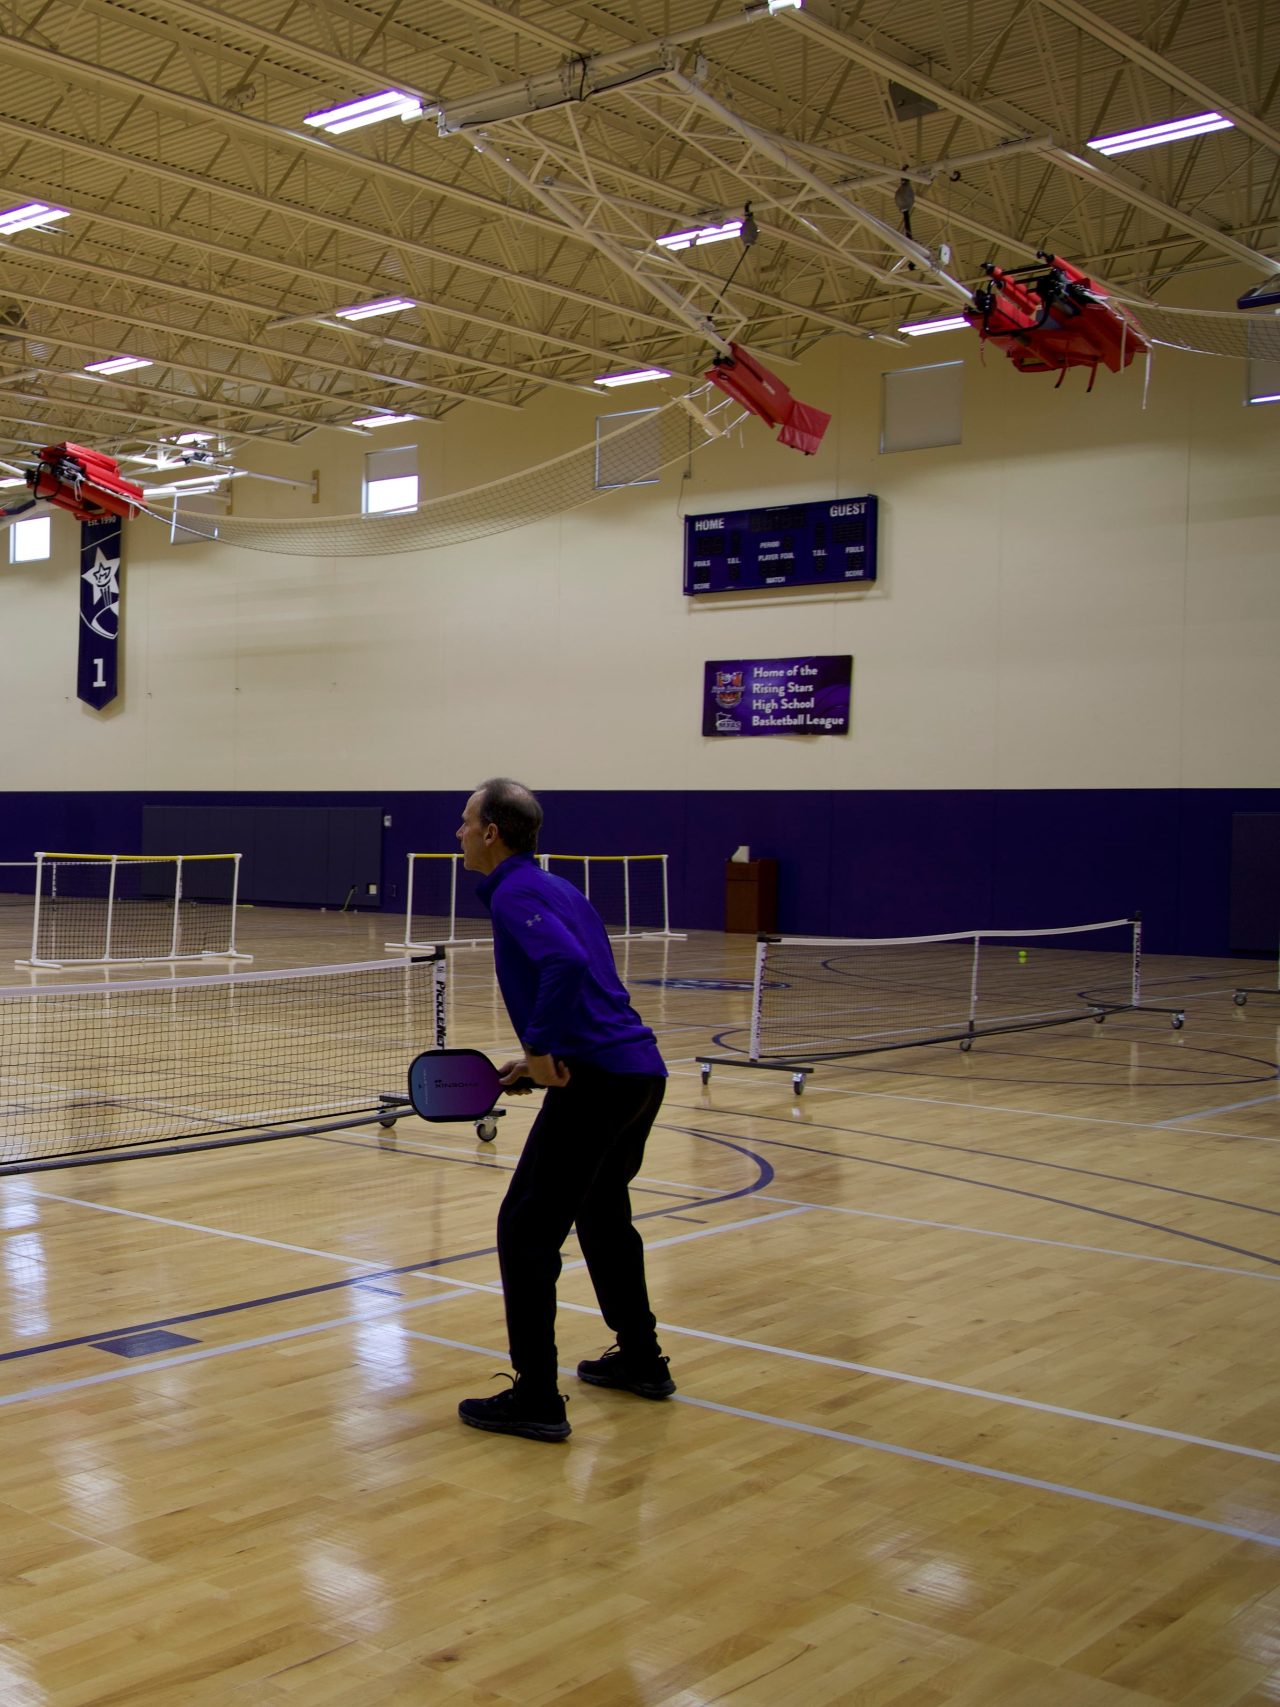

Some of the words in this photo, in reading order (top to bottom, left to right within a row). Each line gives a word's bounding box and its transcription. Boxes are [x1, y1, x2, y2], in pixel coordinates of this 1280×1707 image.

[829, 502, 868, 518] GUEST
[694, 517, 725, 532] HOME
[92, 658, 107, 688] 1
[753, 667, 784, 678] Home
[786, 665, 800, 676] of
[800, 665, 818, 676] the
[752, 683, 785, 697] Rising
[787, 682, 814, 693] Stars
[752, 699, 778, 714] High
[780, 697, 815, 710] School
[752, 714, 804, 727] Basketball
[806, 714, 844, 729] League
